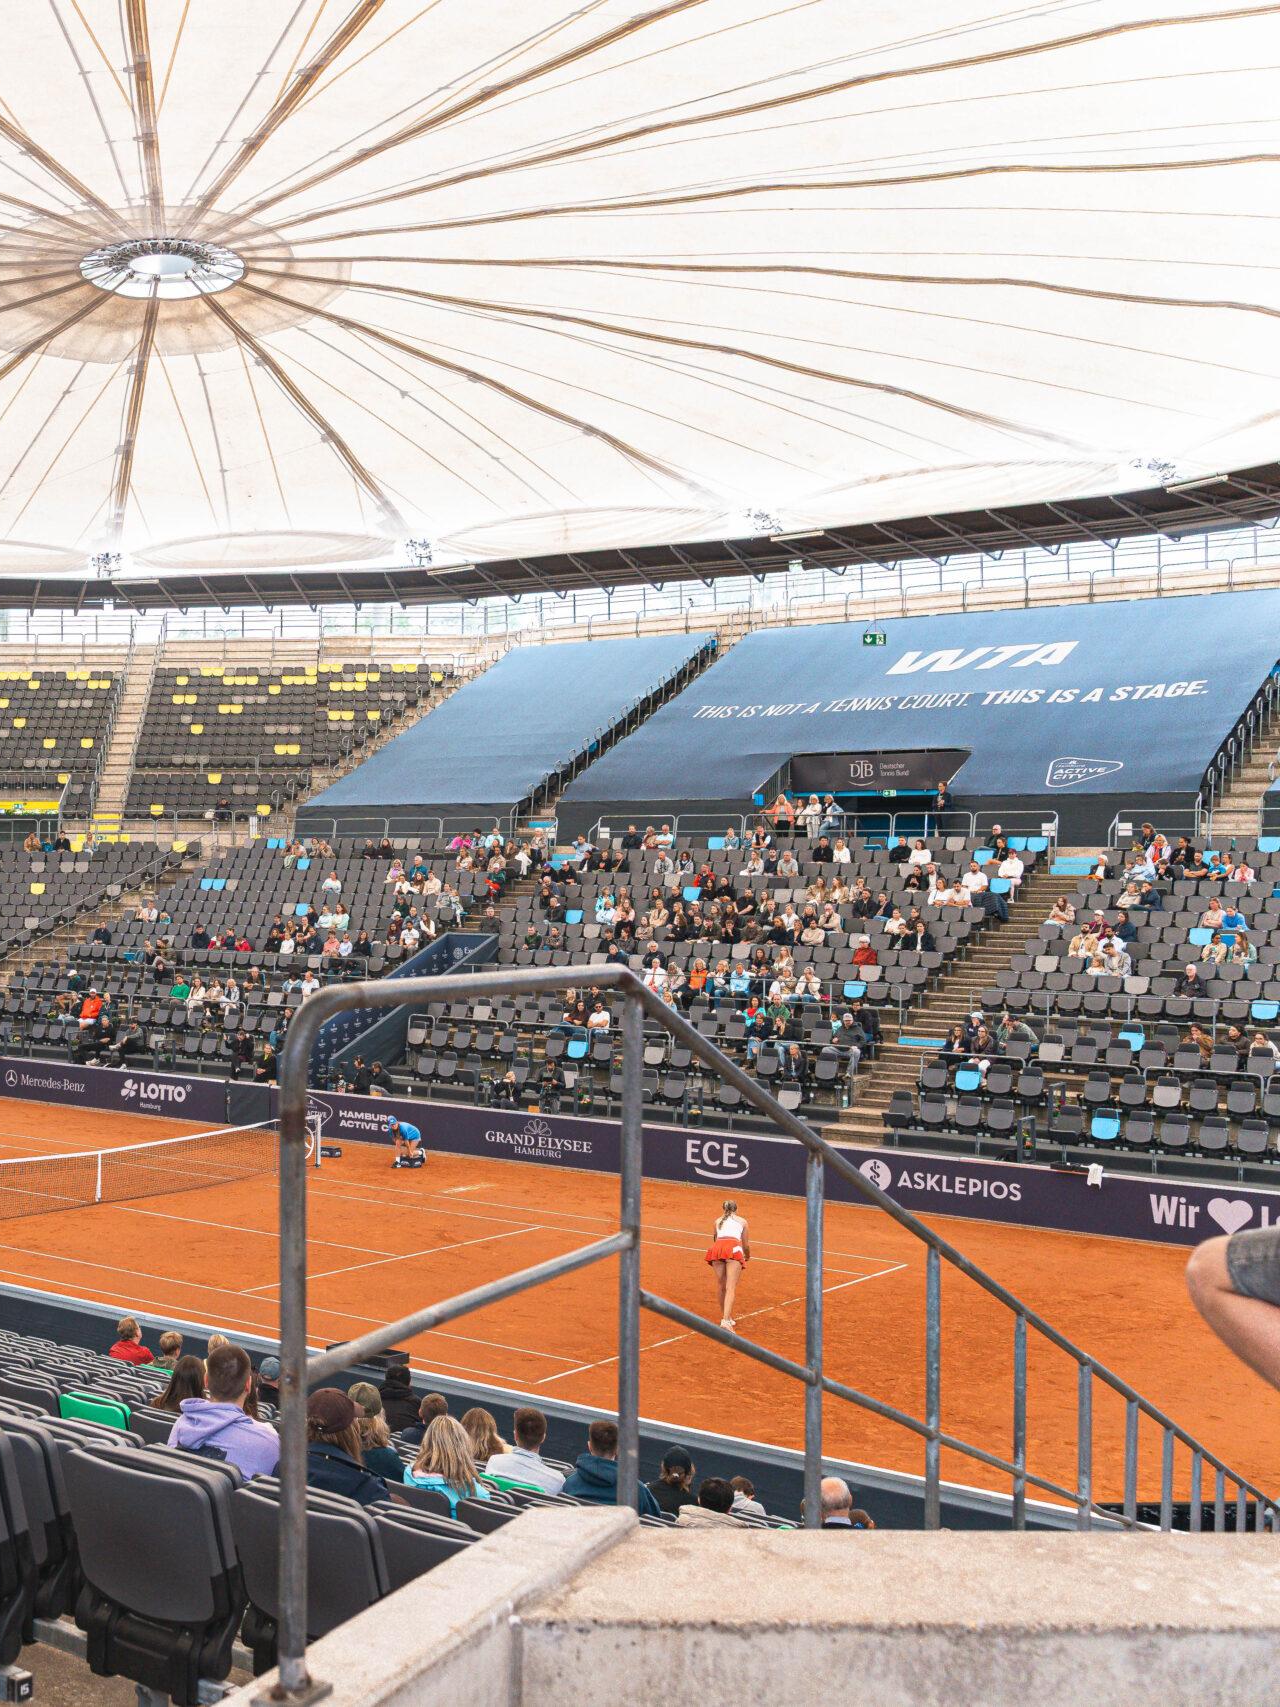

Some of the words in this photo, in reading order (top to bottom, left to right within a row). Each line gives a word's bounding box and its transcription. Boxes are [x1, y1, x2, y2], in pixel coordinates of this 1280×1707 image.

[885, 641, 1080, 675] WTA
[692, 705, 739, 718] THIS
[736, 705, 762, 718] IS
[760, 703, 800, 717] NOT
[800, 702, 822, 714] A
[823, 696, 898, 713] TENNIS
[898, 692, 974, 710] COURT.
[981, 688, 1045, 706] THIS
[1046, 688, 1080, 704] IS
[1079, 687, 1105, 703] A
[1109, 679, 1209, 701] STAGE.
[850, 760, 874, 778] DTB
[20, 1074, 85, 1092] Mercedes-Benz
[140, 1101, 161, 1112] Hamburg
[340, 1120, 379, 1131] ACTIVE
[485, 1130, 535, 1147] GRAND
[538, 1137, 592, 1153] ELYSEE
[514, 1145, 562, 1159] HAMBURG
[686, 1139, 738, 1168] ECE
[897, 1170, 1022, 1202] ASKLEPIOS
[1149, 1193, 1200, 1228] Wir
[20, 1683, 30, 1696] 15
